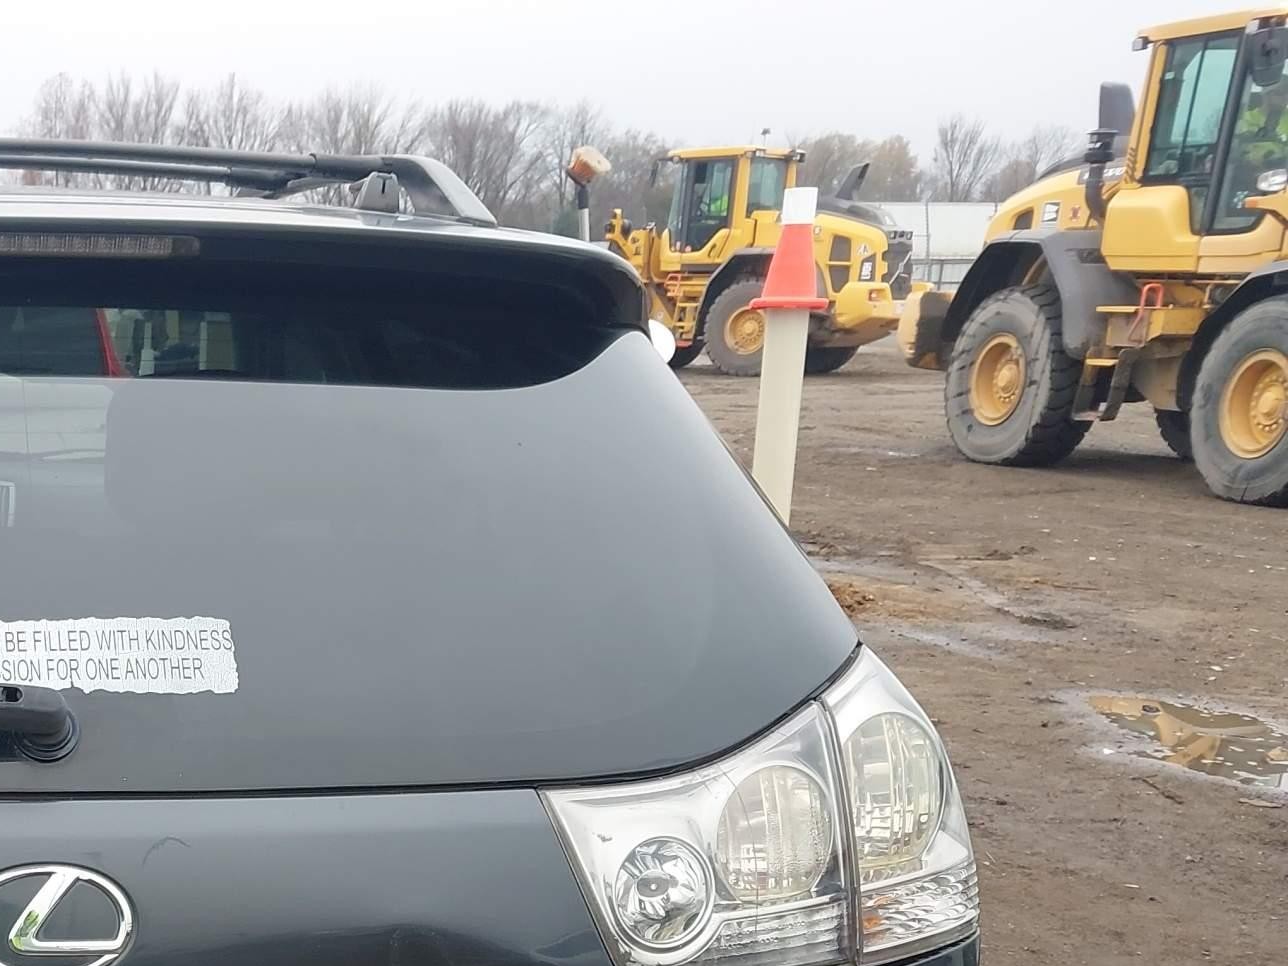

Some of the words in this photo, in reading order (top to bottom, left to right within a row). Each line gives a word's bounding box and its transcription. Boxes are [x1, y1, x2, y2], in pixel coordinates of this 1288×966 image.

[5, 631, 28, 653] BE
[33, 630, 91, 651] FILLED
[96, 630, 140, 652] WITH
[145, 629, 233, 651] KINDNESS
[46, 658, 81, 680] FOR
[85, 658, 120, 680] ONE
[125, 657, 205, 680] ANOTHER
